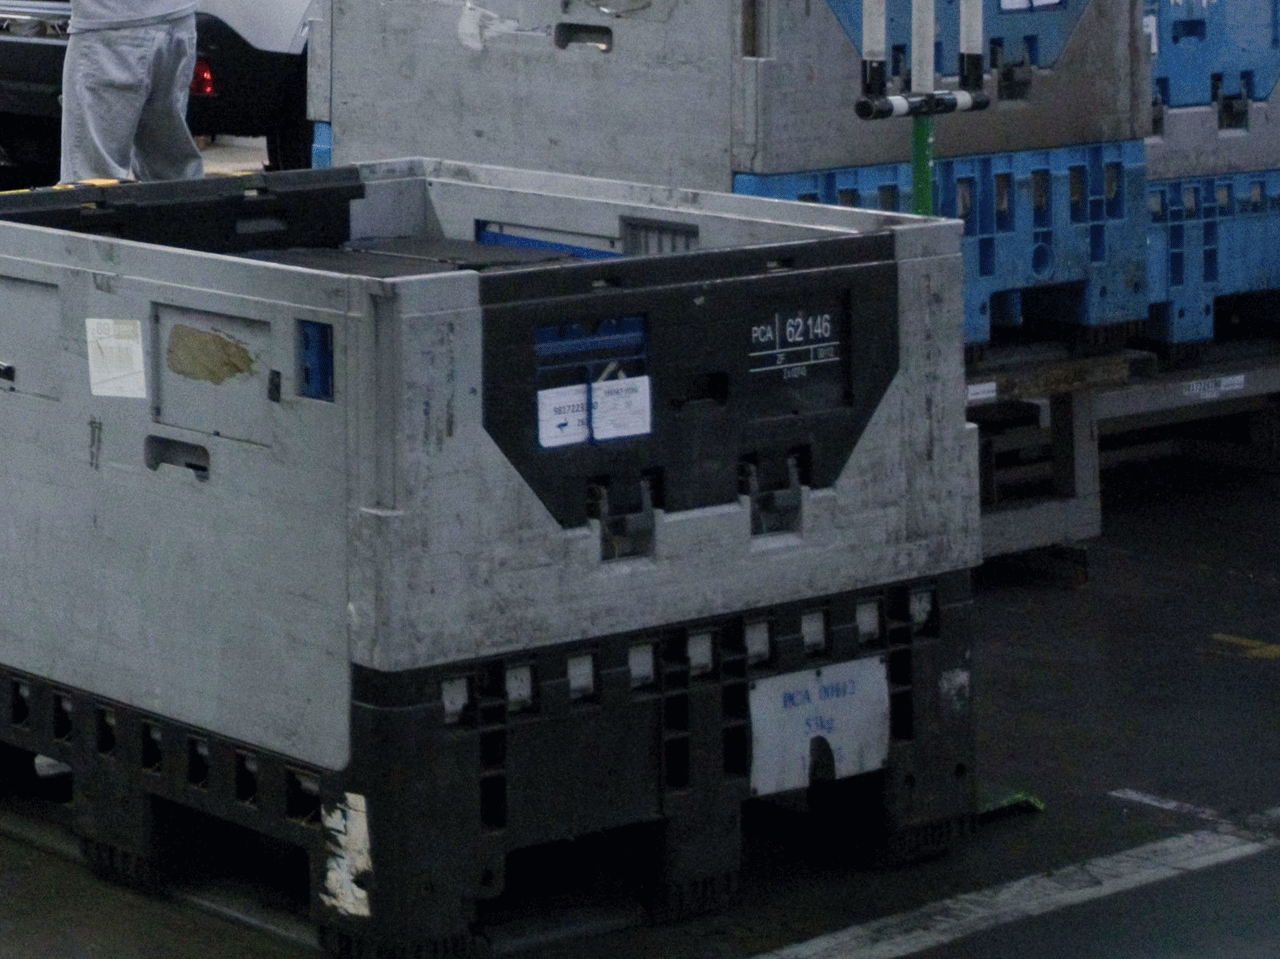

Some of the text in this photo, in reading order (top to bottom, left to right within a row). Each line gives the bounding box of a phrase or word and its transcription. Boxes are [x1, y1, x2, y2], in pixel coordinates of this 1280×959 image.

[751, 313, 831, 343] PCA 62 146
